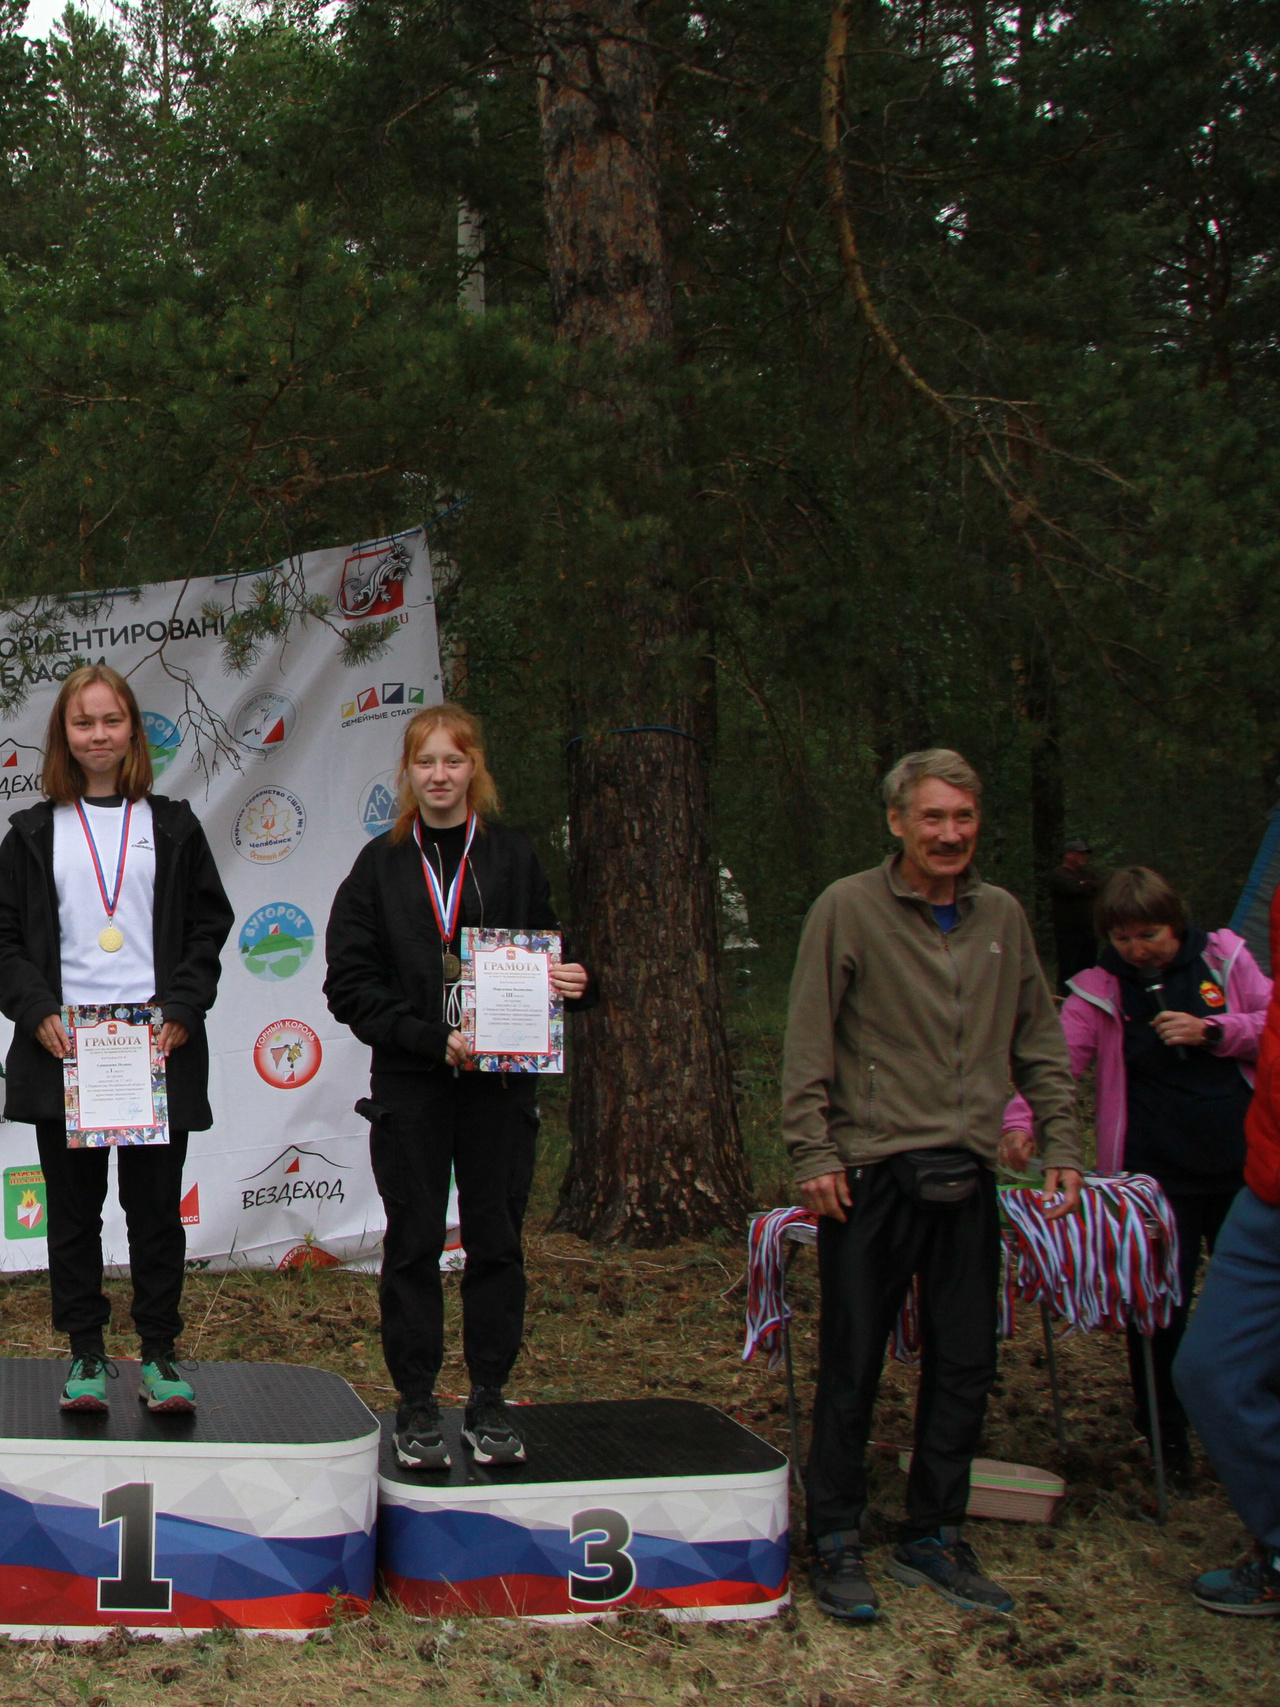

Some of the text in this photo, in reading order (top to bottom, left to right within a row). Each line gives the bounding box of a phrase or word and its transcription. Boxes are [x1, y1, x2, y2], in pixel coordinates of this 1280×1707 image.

[341, 707, 421, 729] СЕМЕЙНЫЕ СТАРТ
[248, 837, 292, 849] Челябинск
[244, 905, 307, 938] БУГОРОК
[483, 961, 541, 972] ГРАМОТА
[84, 1035, 142, 1047] ГРАМОТА
[256, 1019, 317, 1049] ГОРНЫЙ КОРОЛЬ
[241, 1178, 345, 1210] ВЕЗДЕХОД
[97, 1481, 173, 1612] 1
[568, 1507, 637, 1604] 3
